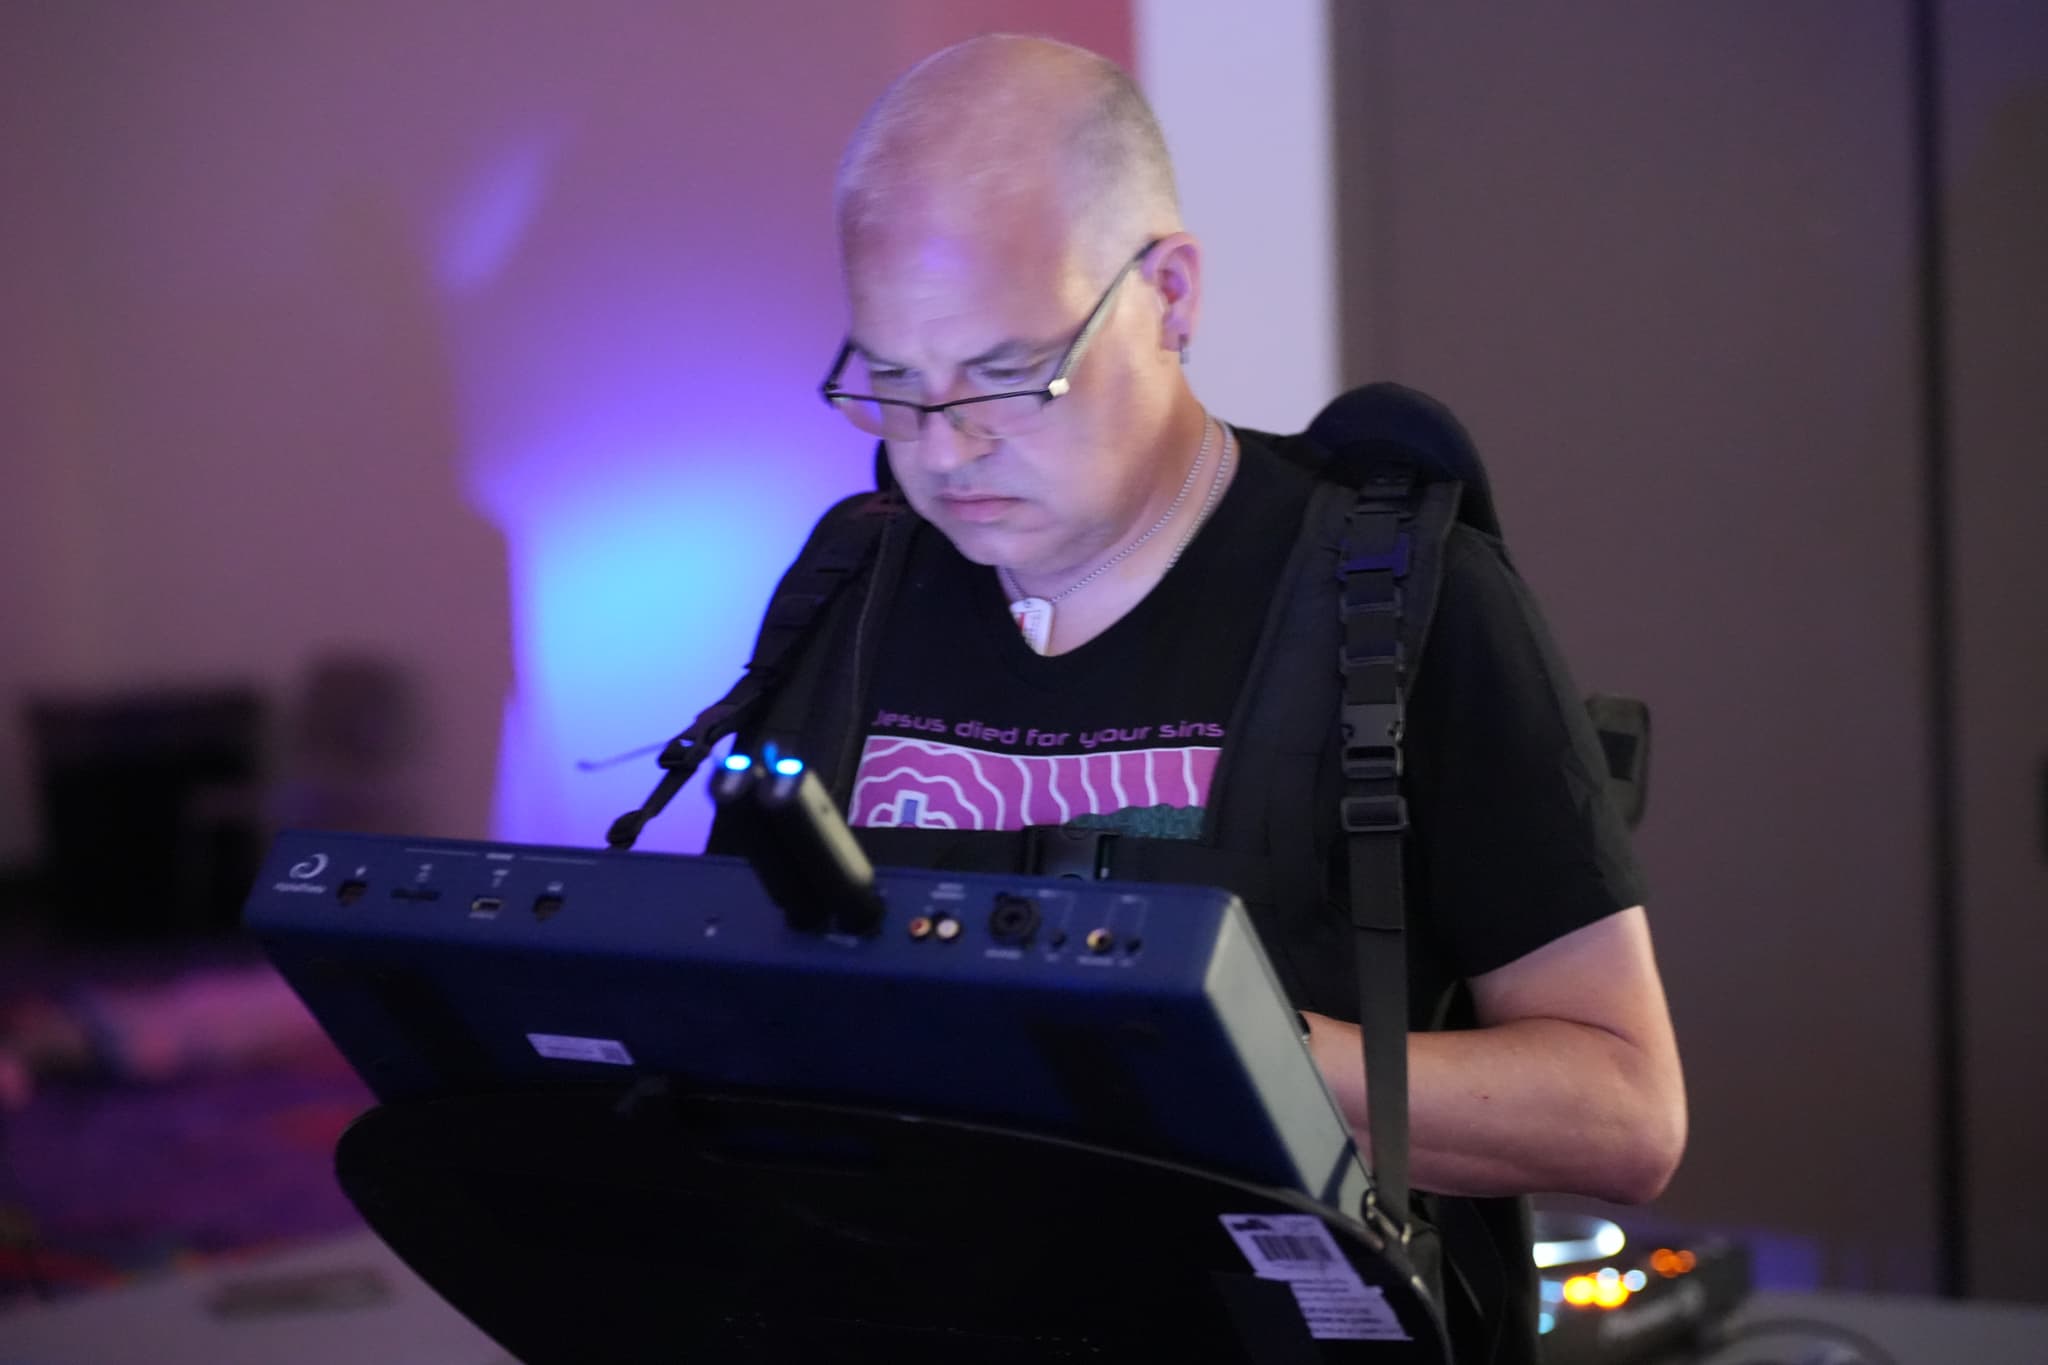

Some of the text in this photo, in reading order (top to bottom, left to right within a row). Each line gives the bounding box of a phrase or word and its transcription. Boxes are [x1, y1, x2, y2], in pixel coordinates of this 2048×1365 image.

[954, 721, 1019, 745] died
[1025, 729, 1070, 747] for
[1079, 727, 1152, 748] your
[1158, 720, 1225, 738] sins
